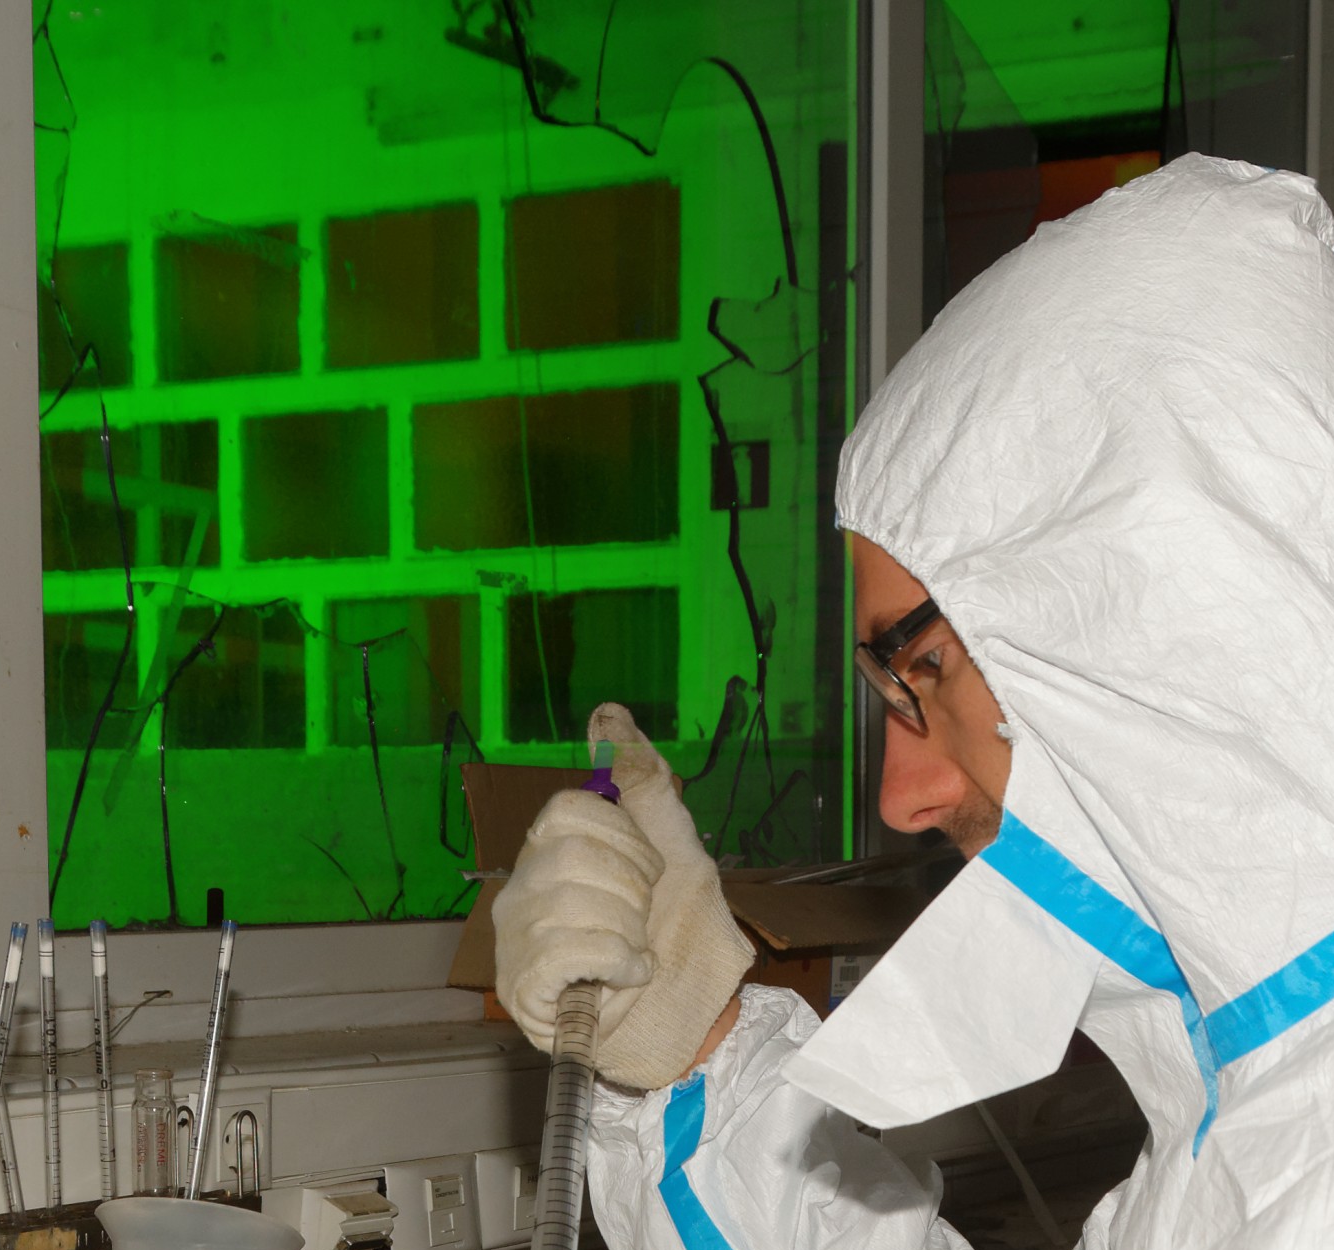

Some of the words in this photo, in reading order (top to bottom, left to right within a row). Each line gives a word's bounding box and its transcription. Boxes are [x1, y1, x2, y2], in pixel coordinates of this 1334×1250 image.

[45, 1017, 57, 1036] 0.1
[48, 1040, 57, 1048] x
[46, 1051, 57, 1075] 5ml
